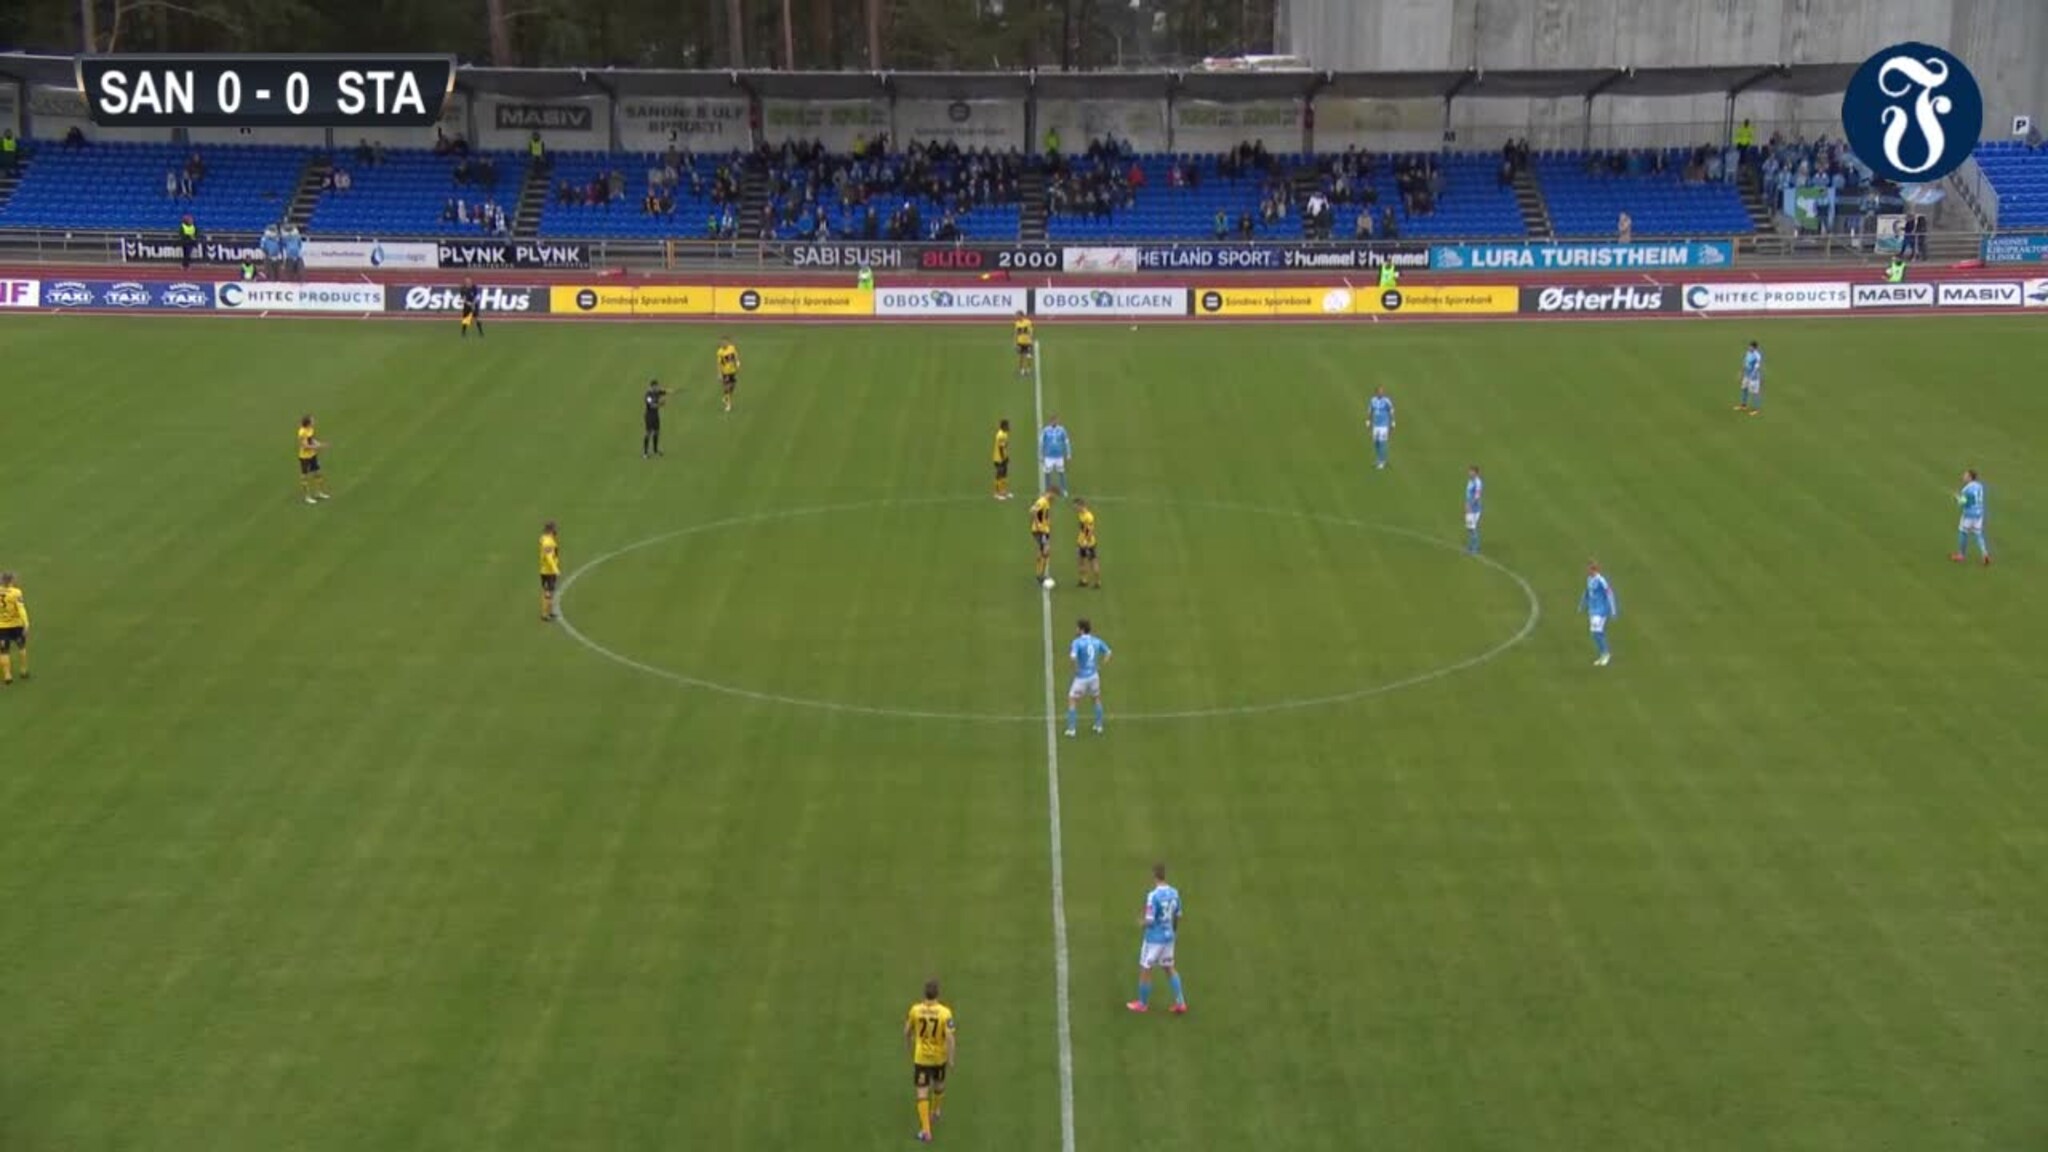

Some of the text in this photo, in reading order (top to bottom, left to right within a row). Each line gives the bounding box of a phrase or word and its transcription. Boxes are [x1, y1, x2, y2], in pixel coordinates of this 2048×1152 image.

[2015, 119, 2027, 132] P
[792, 246, 902, 267] SABI SUSHI
[922, 249, 1058, 268] auto 2000
[1138, 249, 1214, 267] HETLAND
[1217, 249, 1272, 267] SPORT
[1294, 250, 1355, 267] hummel
[1471, 247, 1689, 267] LURA TURISTHEIM
[53, 292, 89, 301] TAXI
[110, 292, 147, 302] TAXI
[168, 293, 202, 303] TAXI
[247, 290, 381, 303] HITEC PRODUCTS
[882, 294, 1013, 308] OBOS LIGAEN
[1043, 294, 1173, 308] OBOS LIGAEN
[1537, 286, 1663, 312] ØsterHus
[1714, 290, 1847, 303] HITEC PRODUCTS
[1858, 288, 1928, 302] MASIV
[1943, 288, 2017, 301] MASIV
